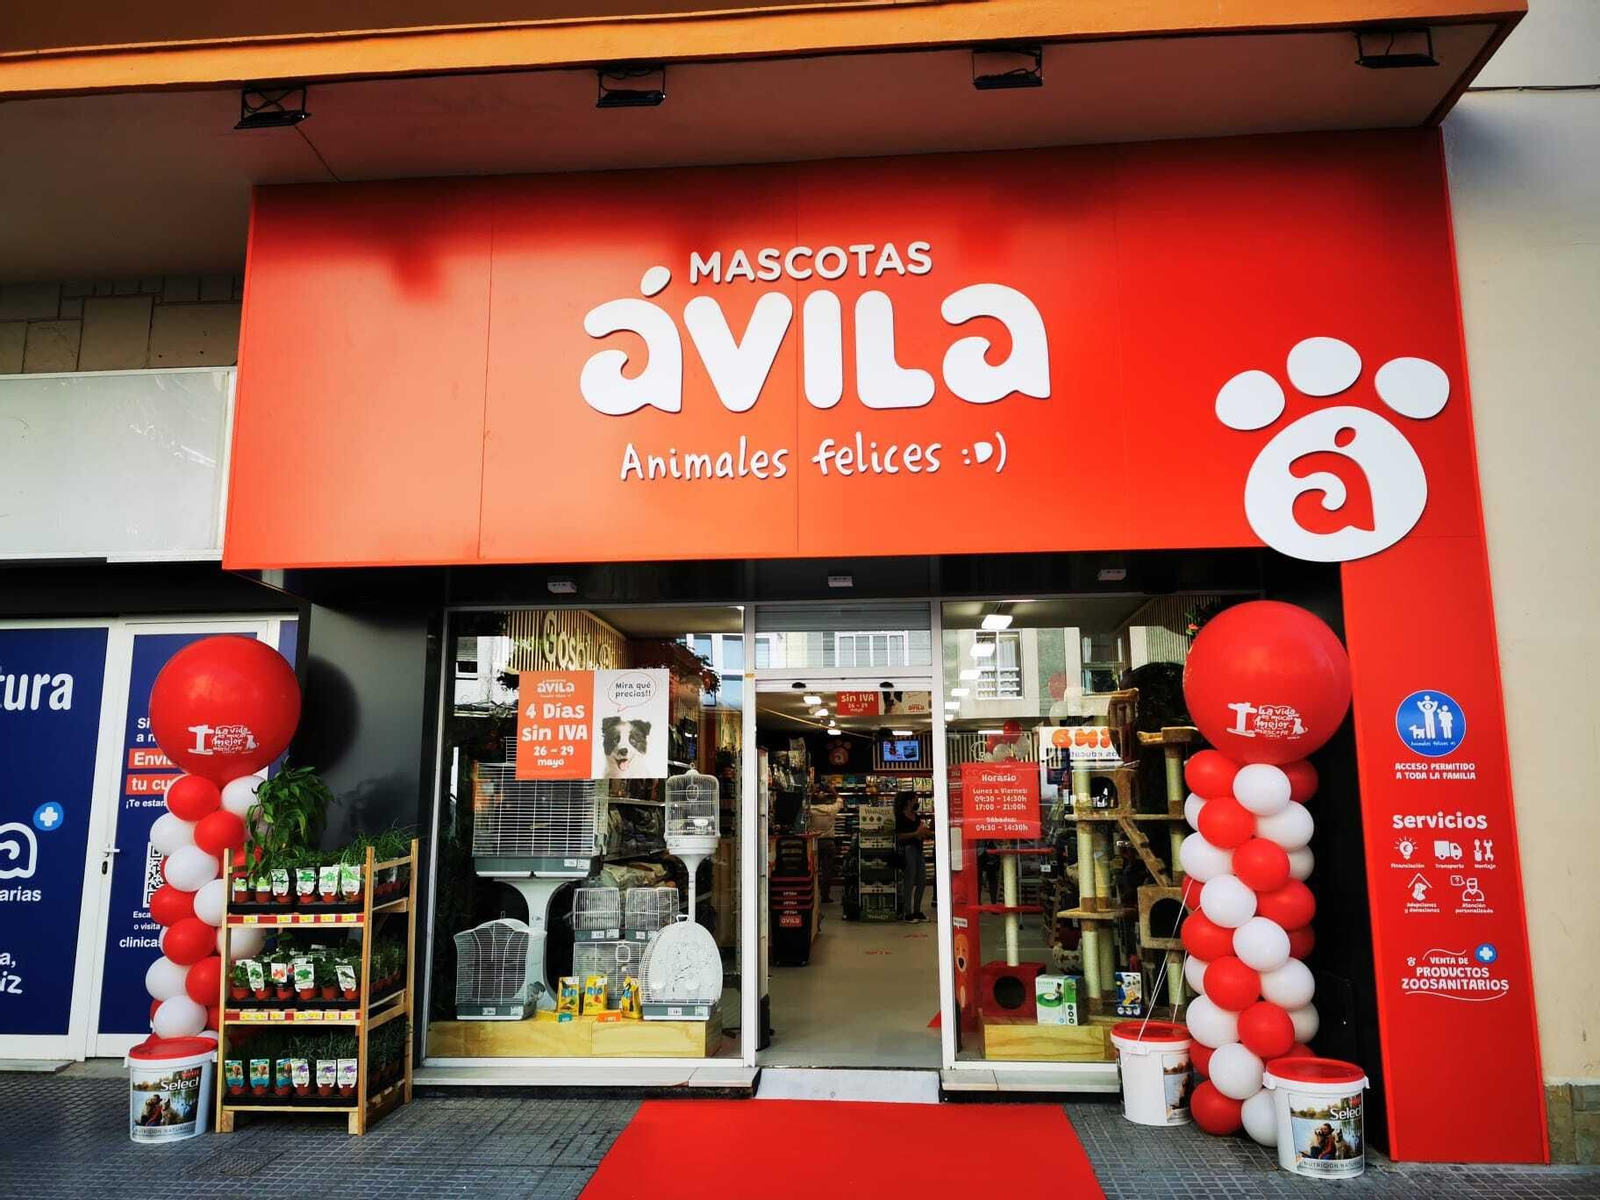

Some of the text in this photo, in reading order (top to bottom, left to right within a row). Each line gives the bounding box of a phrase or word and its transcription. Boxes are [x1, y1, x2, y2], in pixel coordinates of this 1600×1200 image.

[690, 241, 933, 285] MASCOTAS
[620, 435, 788, 480] Animales
[812, 431, 942, 476] felices
[636, 682, 651, 692] qué
[0, 674, 74, 711] ura
[615, 690, 651, 698] precios!!
[841, 693, 874, 702] sin IVA
[526, 703, 585, 718] 4 Días
[136, 733, 144, 742] a
[522, 724, 588, 741] sin IVA
[534, 746, 547, 756] 26
[560, 746, 574, 756] 29
[538, 758, 564, 768] mayo
[1395, 763, 1475, 771] ACCESO PERMITIDO
[982, 774, 1016, 782] Horario
[131, 778, 147, 791] tu
[1392, 811, 1488, 829] servicios
[1416, 967, 1489, 977] PRODUCTOS
[1402, 978, 1509, 990] ZOOSANITARIOS
